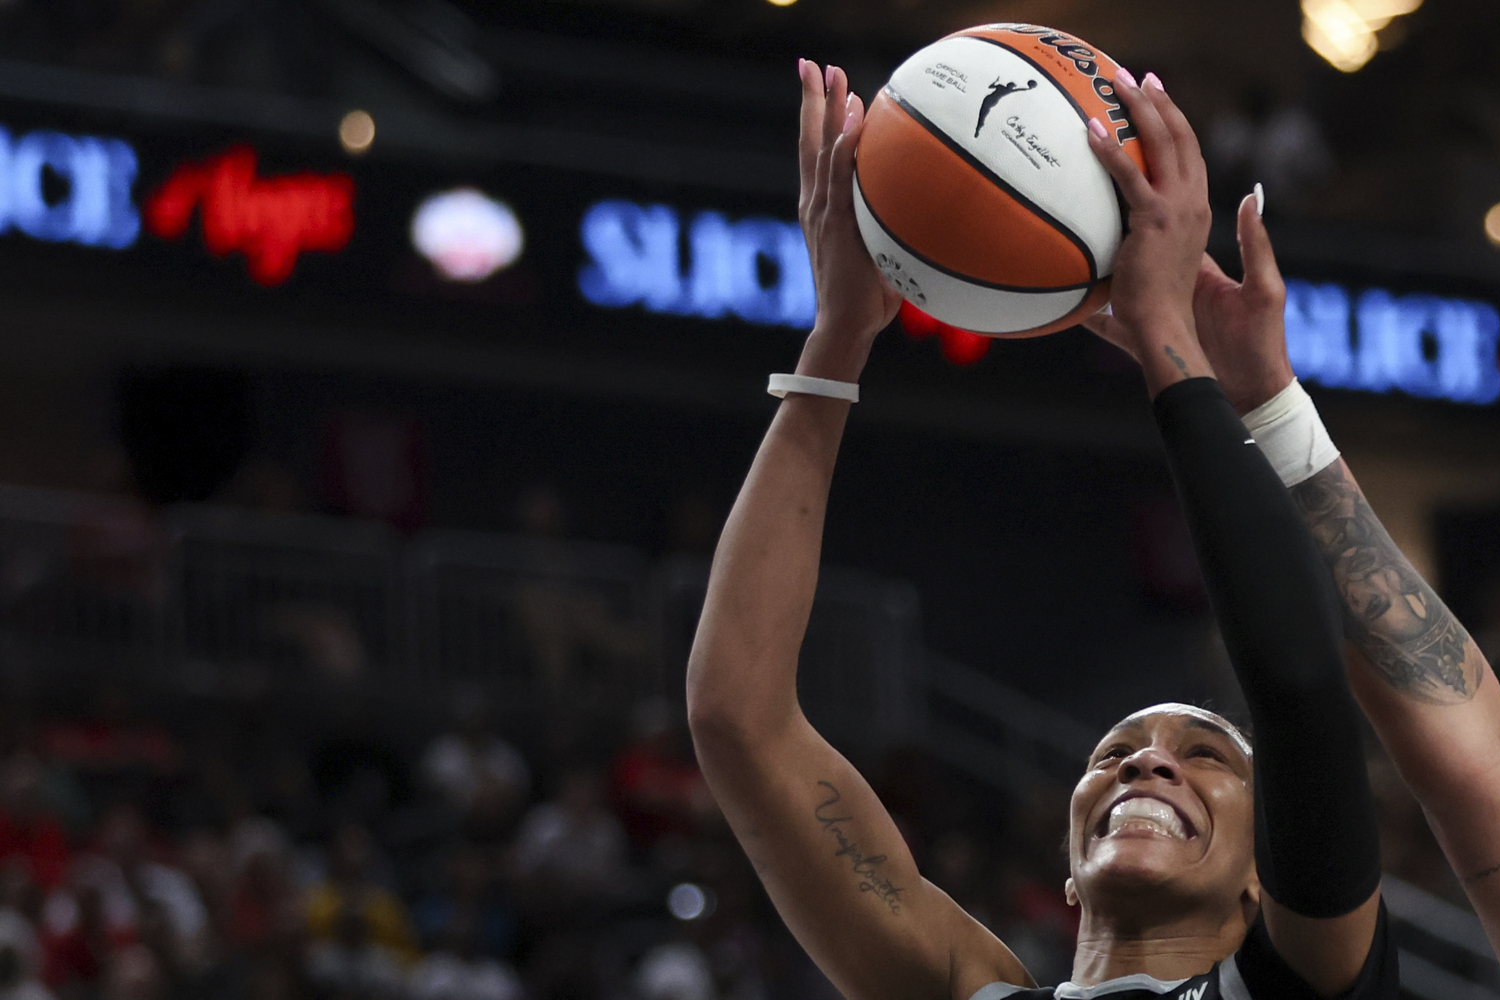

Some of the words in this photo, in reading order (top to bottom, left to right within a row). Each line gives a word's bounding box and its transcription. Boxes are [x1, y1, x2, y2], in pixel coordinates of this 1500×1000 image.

[924, 67, 947, 81] GAME
[946, 76, 967, 93] BALL
[935, 62, 969, 83] OFFICIAL
